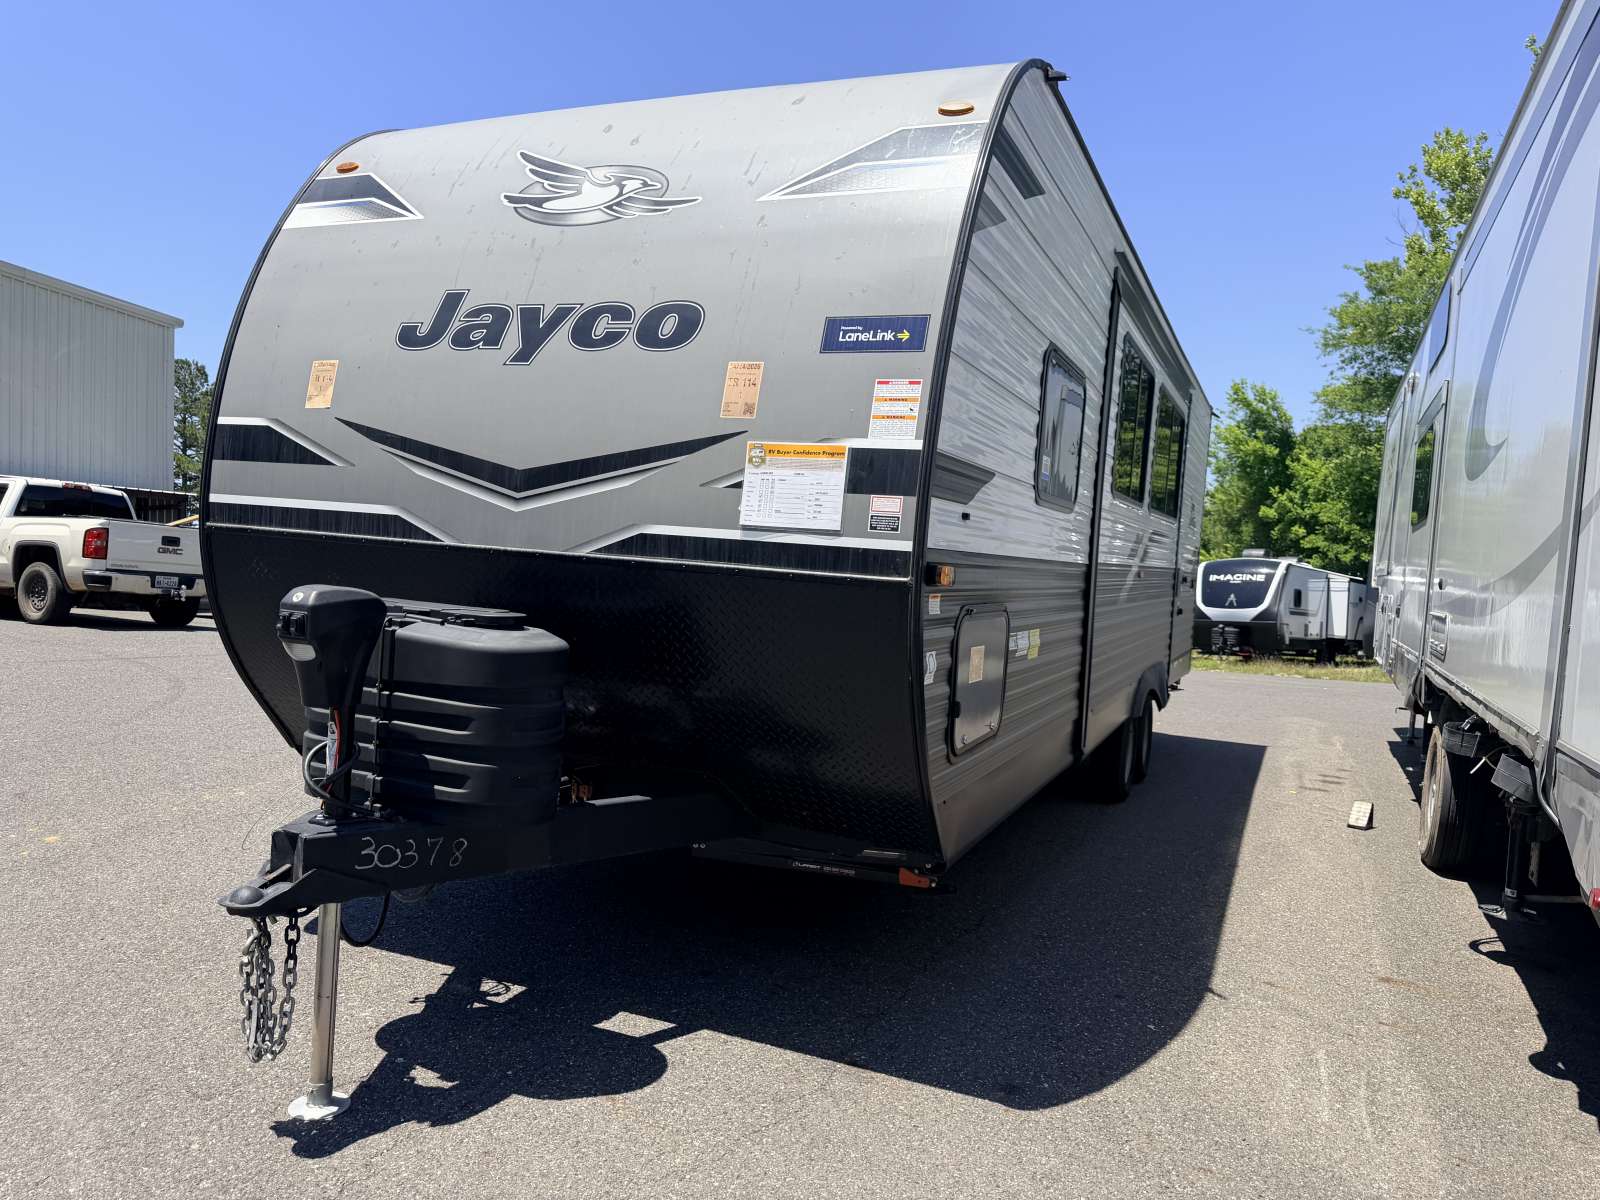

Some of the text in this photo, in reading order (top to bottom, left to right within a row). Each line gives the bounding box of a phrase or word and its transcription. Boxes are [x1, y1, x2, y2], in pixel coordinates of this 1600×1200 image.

[396, 288, 705, 365] Jayco
[839, 330, 896, 342] LaneLink
[157, 547, 184, 555] GMC
[1209, 573, 1265, 582] IMAGINE
[354, 836, 468, 869] 30378
